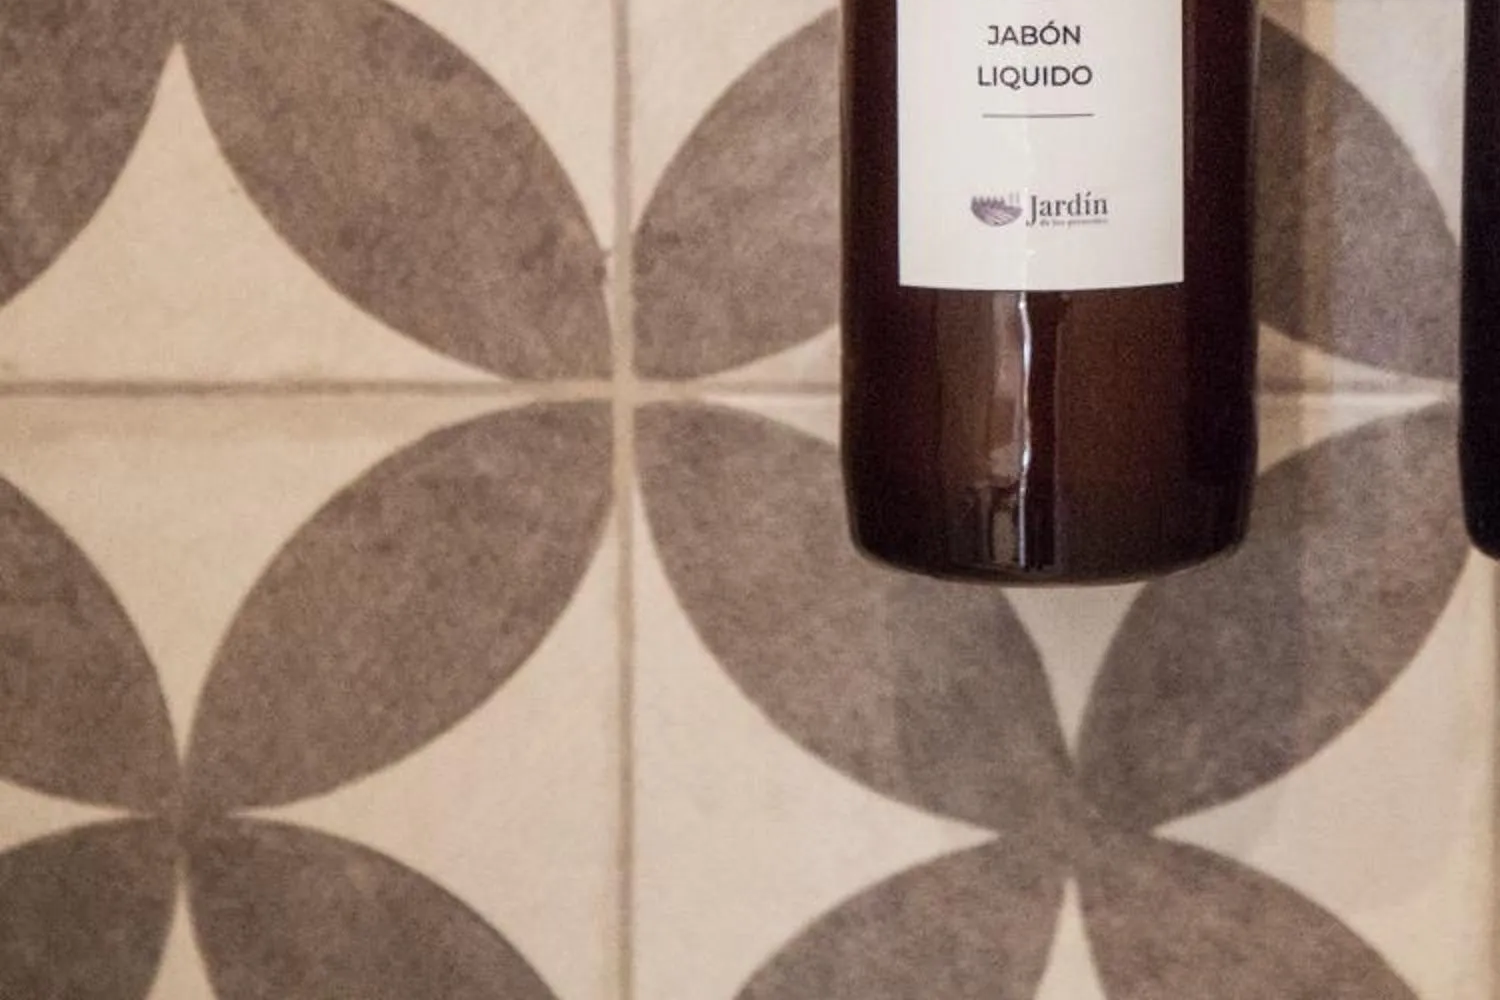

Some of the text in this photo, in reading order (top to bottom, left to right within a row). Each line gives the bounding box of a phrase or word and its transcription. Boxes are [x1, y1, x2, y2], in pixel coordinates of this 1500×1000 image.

[987, 20, 1082, 46] JABÓN
[977, 65, 1094, 91] LIQUIDO
[1025, 191, 1108, 228] Jardín
